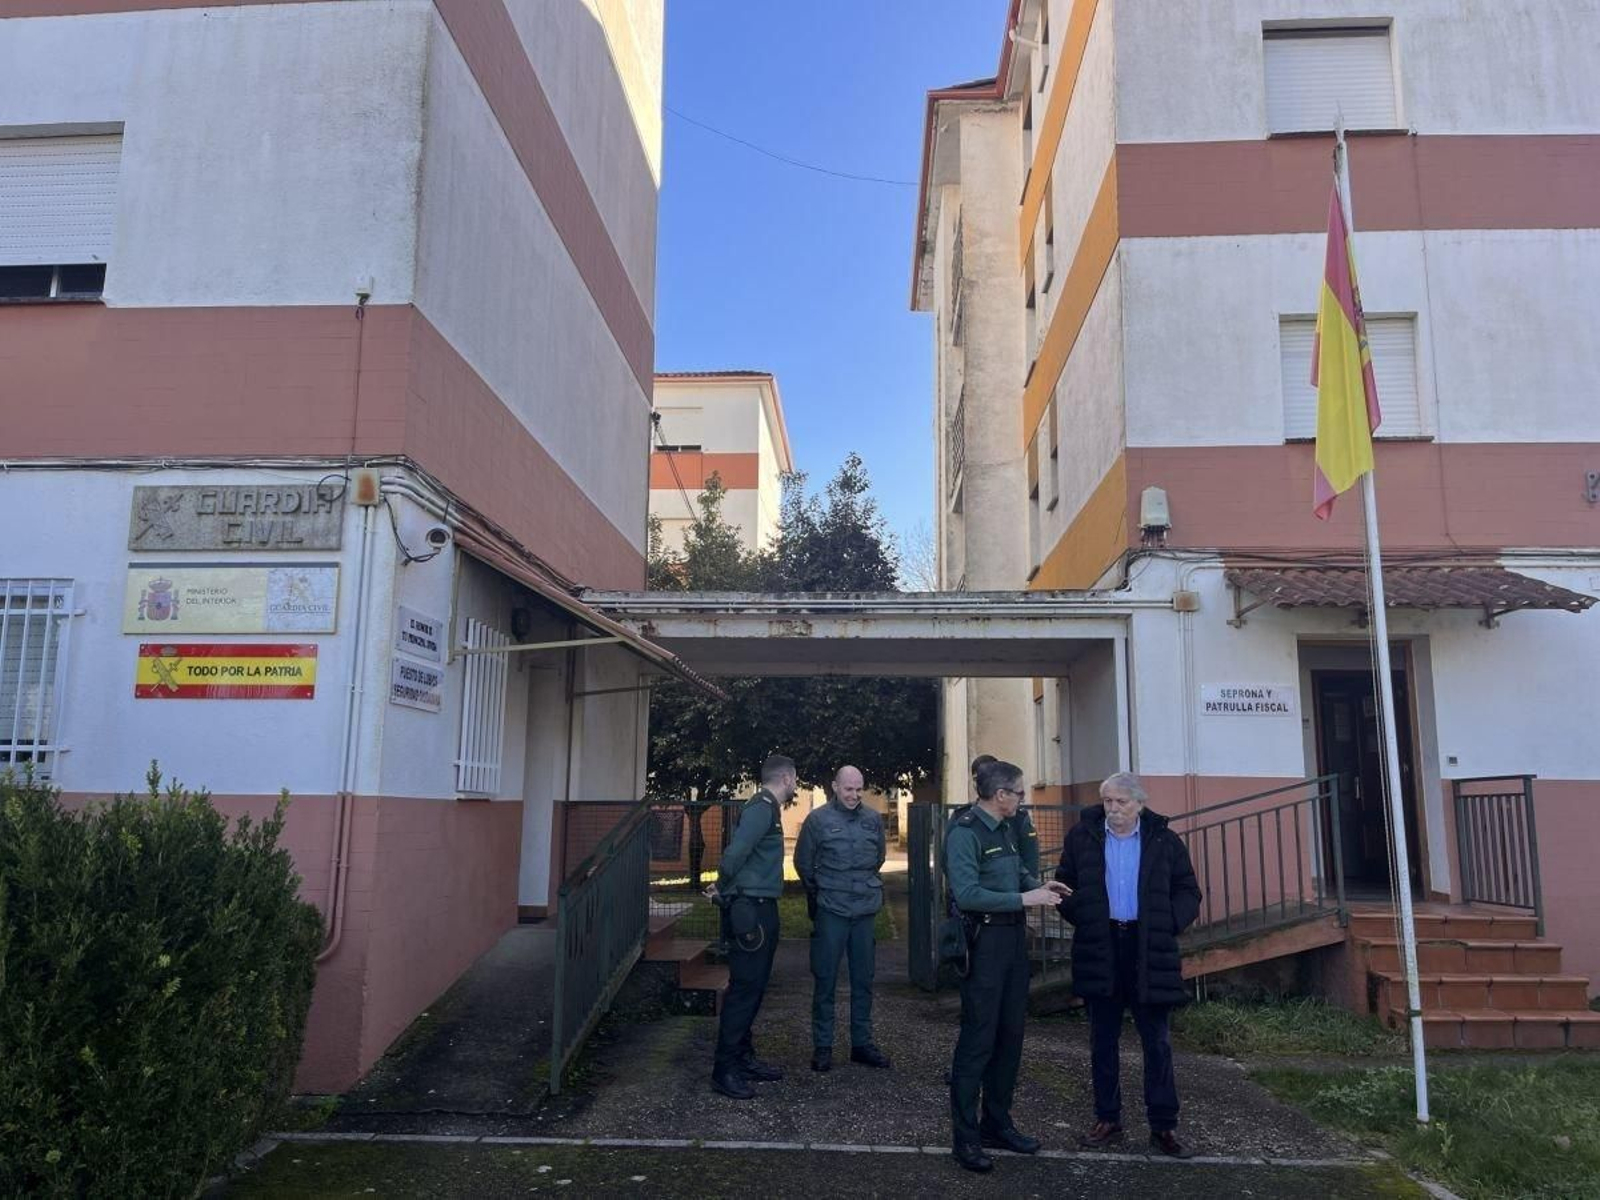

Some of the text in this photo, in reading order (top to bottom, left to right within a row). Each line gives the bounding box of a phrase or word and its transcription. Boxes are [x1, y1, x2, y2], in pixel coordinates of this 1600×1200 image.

[197, 488, 333, 515] GUARDIA
[222, 520, 303, 545] CIVIL
[186, 588, 229, 596] MINISTERIO
[186, 597, 238, 606] DEL INTERIOR
[269, 604, 331, 613] GUARDIA CIVIL
[187, 666, 303, 677] TODO POR LA PATRIA
[1220, 688, 1273, 699] SEPRONA Y
[1205, 702, 1289, 712] PATRULLA FISCAL
